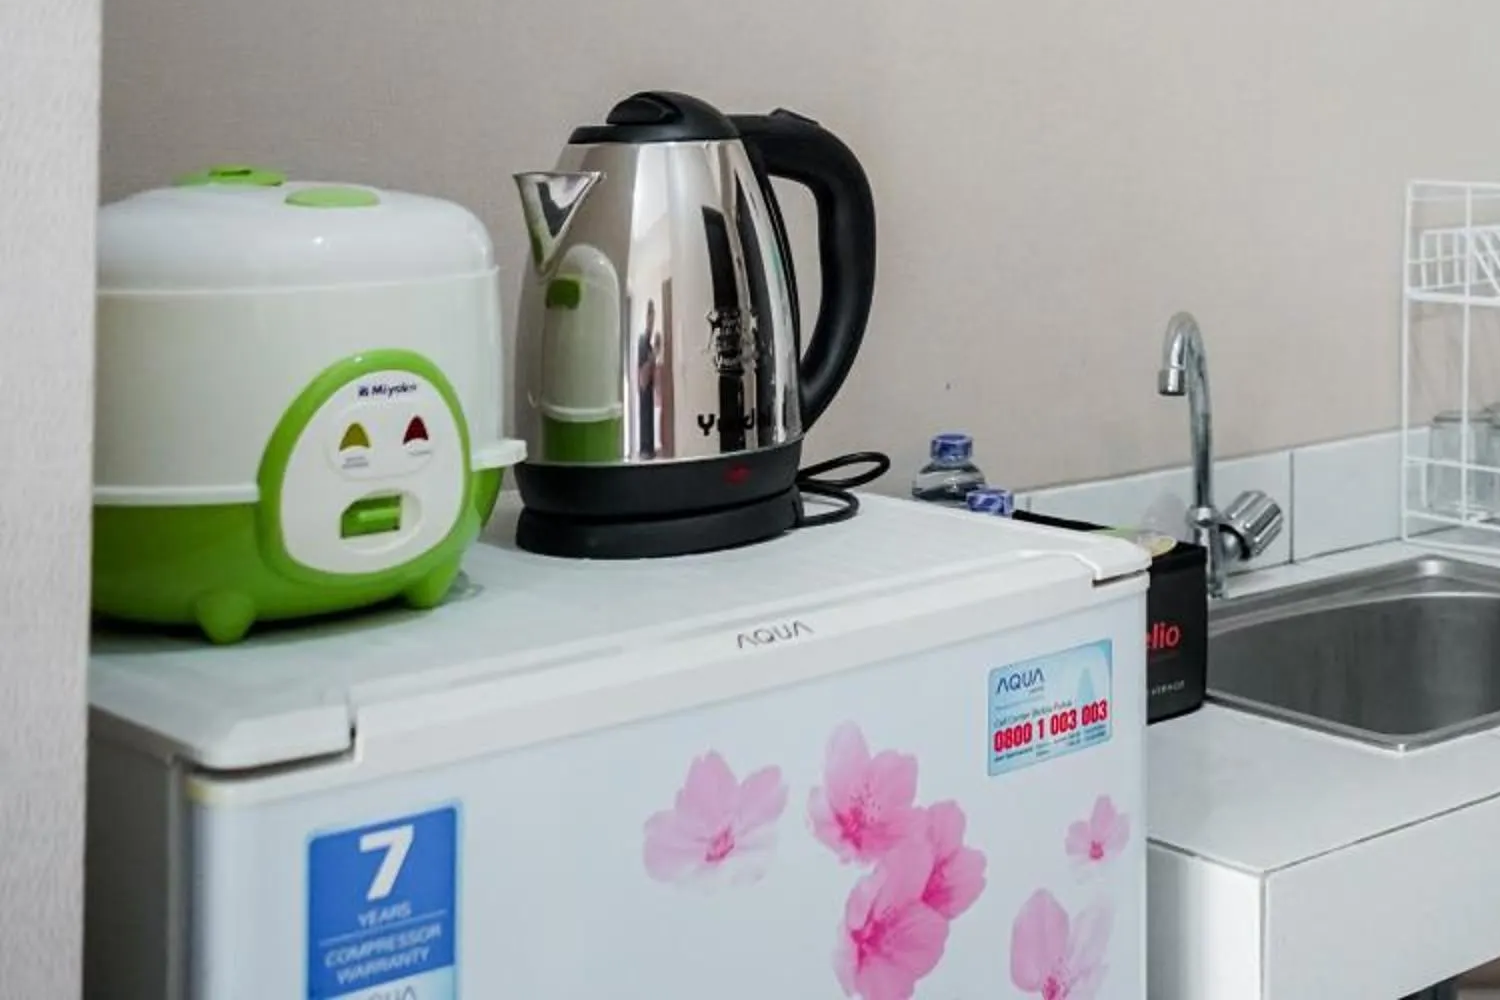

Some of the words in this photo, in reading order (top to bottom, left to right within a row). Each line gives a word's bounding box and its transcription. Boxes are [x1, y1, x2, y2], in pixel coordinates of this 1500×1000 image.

[371, 382, 417, 398] Miyako
[737, 619, 815, 649] AQUA
[997, 667, 1045, 695] AQUA
[994, 721, 1033, 753] 0800
[1037, 717, 1045, 740] 1
[1050, 708, 1077, 736] 003
[1081, 698, 1107, 726] 003
[359, 824, 415, 902] 7
[357, 902, 413, 928] YEARS
[324, 923, 442, 969] COMPRESSOR
[336, 946, 431, 985] WARRANTY
